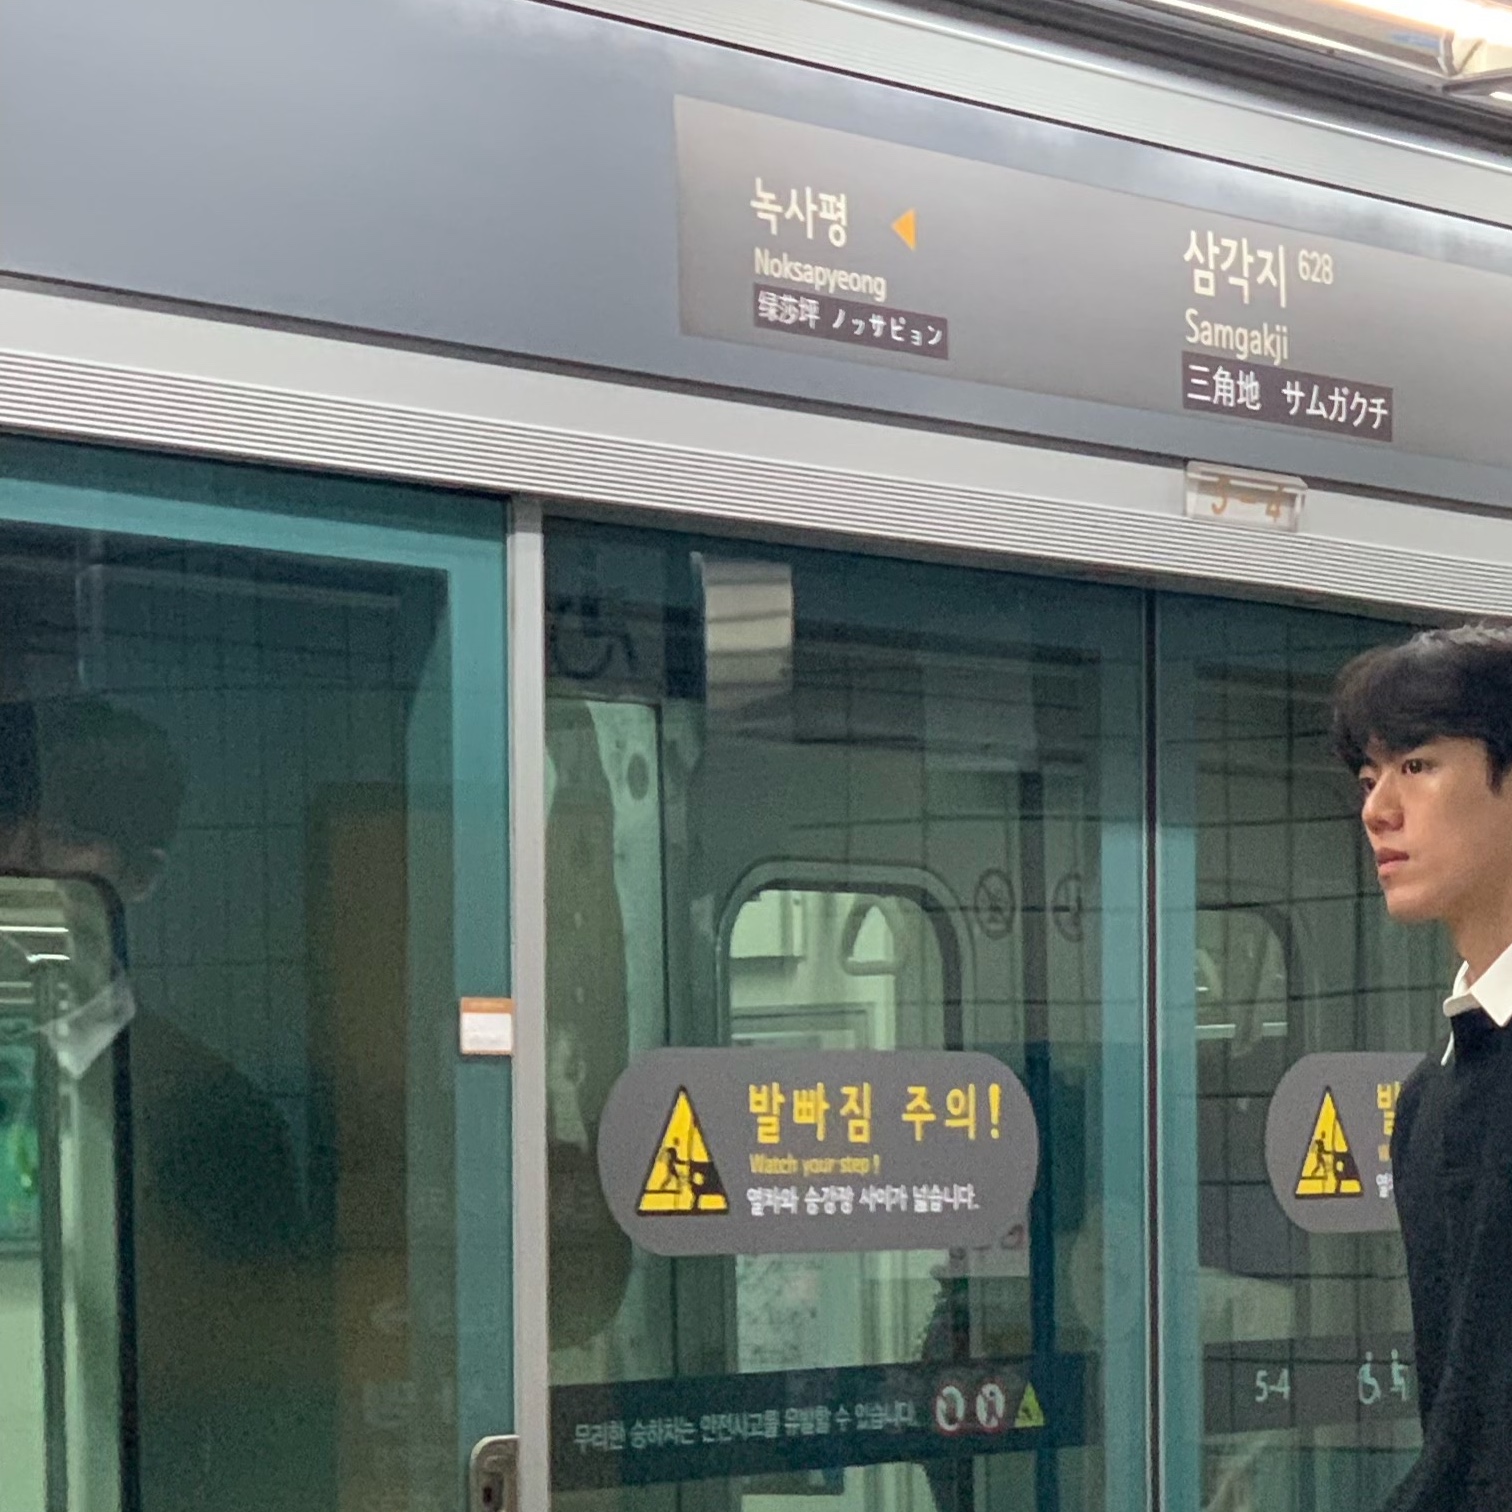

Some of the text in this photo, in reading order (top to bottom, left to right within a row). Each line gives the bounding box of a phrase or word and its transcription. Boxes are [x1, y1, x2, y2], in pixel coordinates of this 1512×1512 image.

[750, 177, 848, 248] 녹사평
[754, 246, 887, 303] Noksapyeong
[1183, 230, 1335, 309] 삼각지 628
[1185, 307, 1289, 366] Samgakji
[1186, 364, 1389, 430] 三角地 サムガクチ
[749, 1081, 1002, 1144] 발빠짐 주의!
[750, 1152, 798, 1174] Watch
[802, 1157, 836, 1178] your
[804, 1184, 855, 1216] 승강장
[859, 1183, 909, 1213] 사이가
[574, 1419, 626, 1454] 무리한
[835, 1402, 852, 1433] 수
